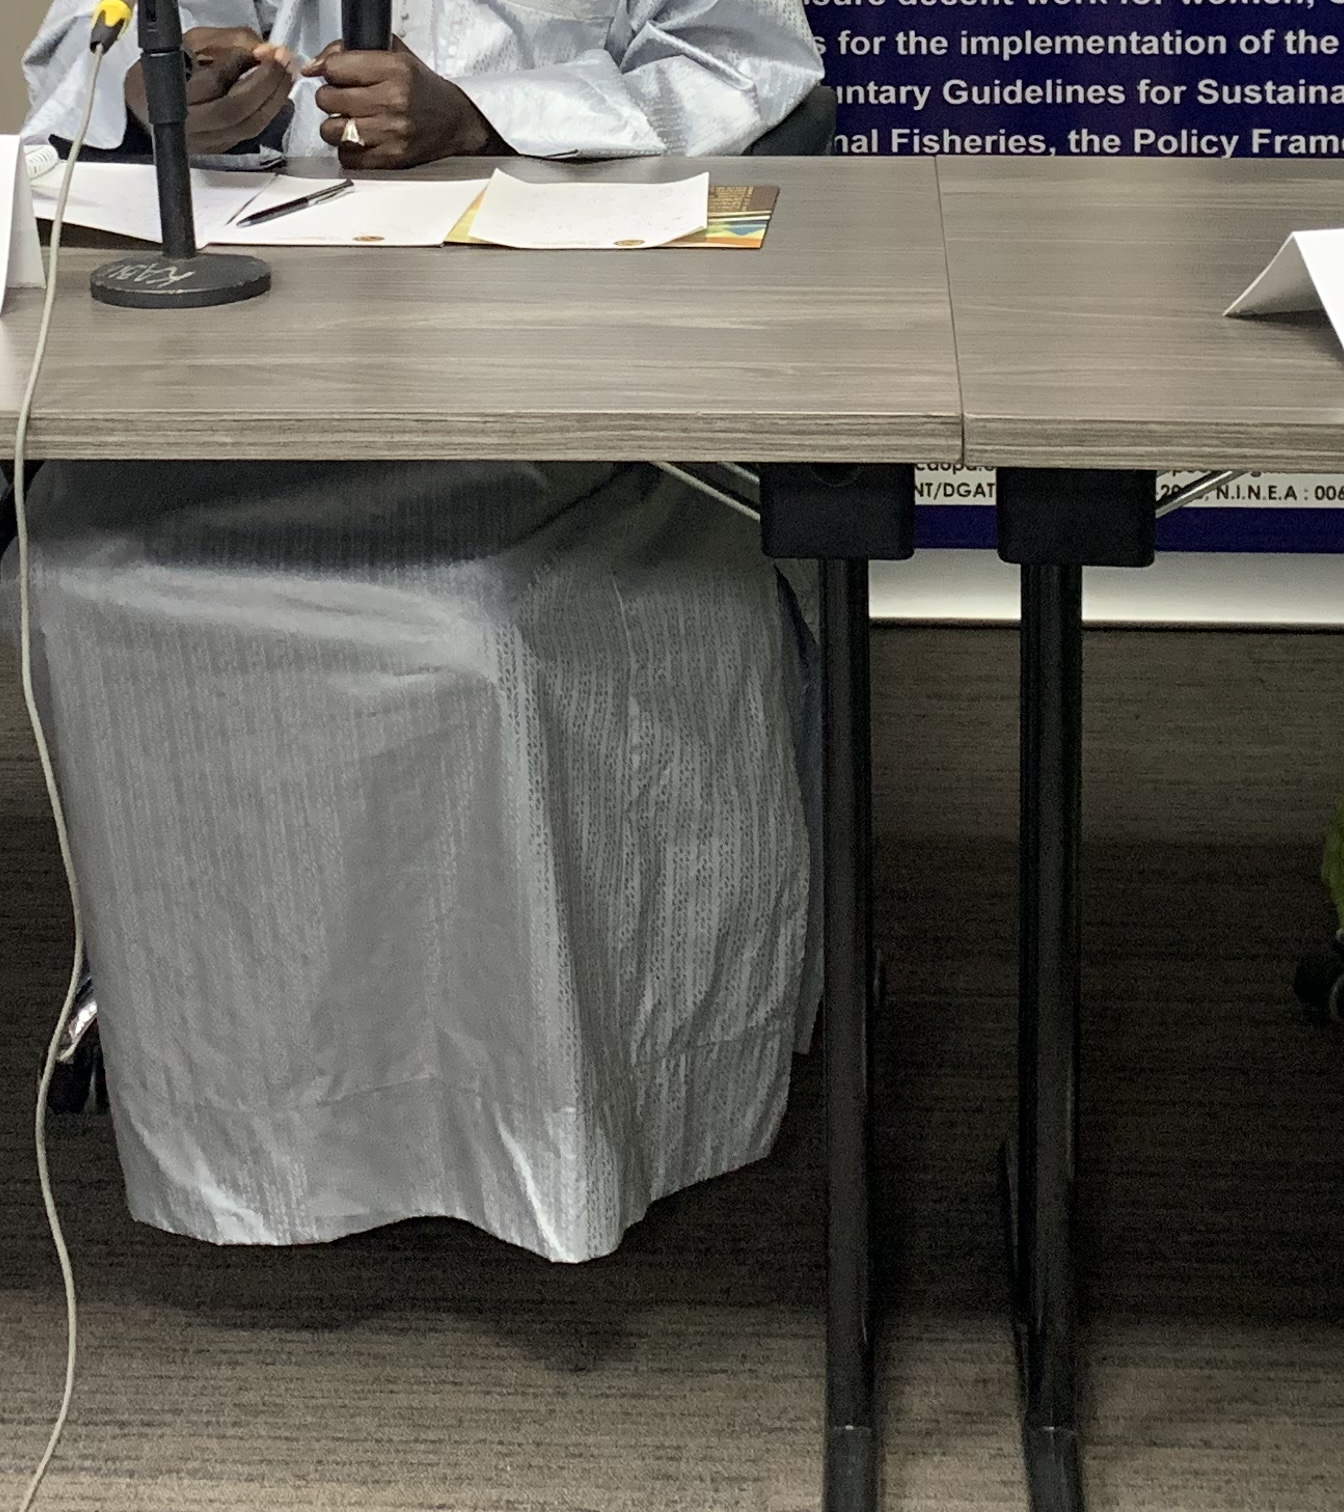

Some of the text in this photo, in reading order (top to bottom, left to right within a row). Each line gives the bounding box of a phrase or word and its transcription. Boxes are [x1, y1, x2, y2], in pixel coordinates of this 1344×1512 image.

[838, 30, 885, 54] for
[896, 31, 948, 55] the
[961, 30, 1226, 60] implementation
[1240, 29, 1275, 54] of
[1285, 29, 1339, 54] the
[943, 79, 1125, 104] Guidelines
[1137, 79, 1186, 104] for
[892, 129, 1056, 156] Fisheries,
[1068, 129, 1121, 154] the
[1134, 129, 1238, 158] Policy
